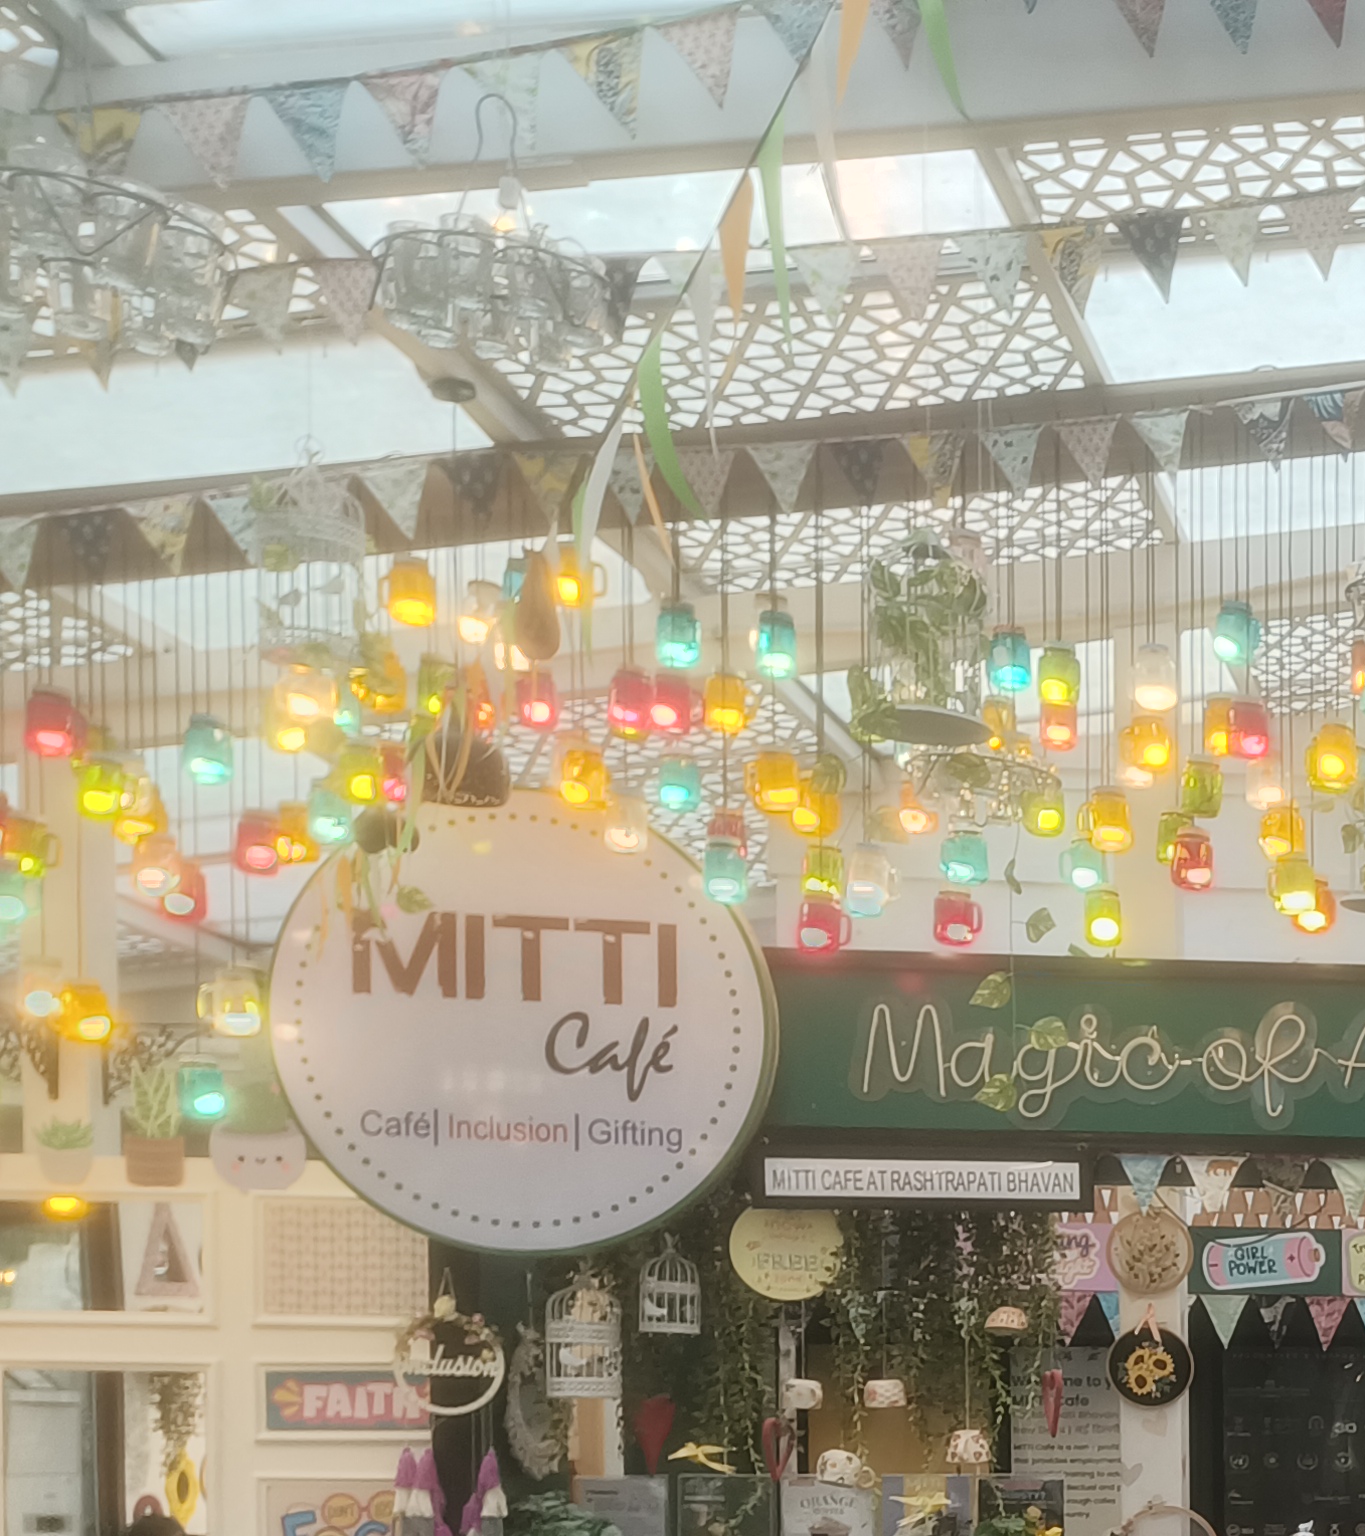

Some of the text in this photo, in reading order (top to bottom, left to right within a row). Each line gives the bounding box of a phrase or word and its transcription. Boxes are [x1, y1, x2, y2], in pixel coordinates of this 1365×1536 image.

[352, 912, 678, 1008] MITTI
[545, 1011, 678, 1102] Café
[861, 1003, 1178, 1119] Magic
[1200, 1014, 1318, 1119] of
[360, 1108, 683, 1153] Café Inclusion Gifting
[772, 1168, 1074, 1193] MITTI CAFE AT RASHTRAPATI BHAVAN
[1228, 1259, 1277, 1276] POWER
[1234, 1246, 1268, 1262] GIRL
